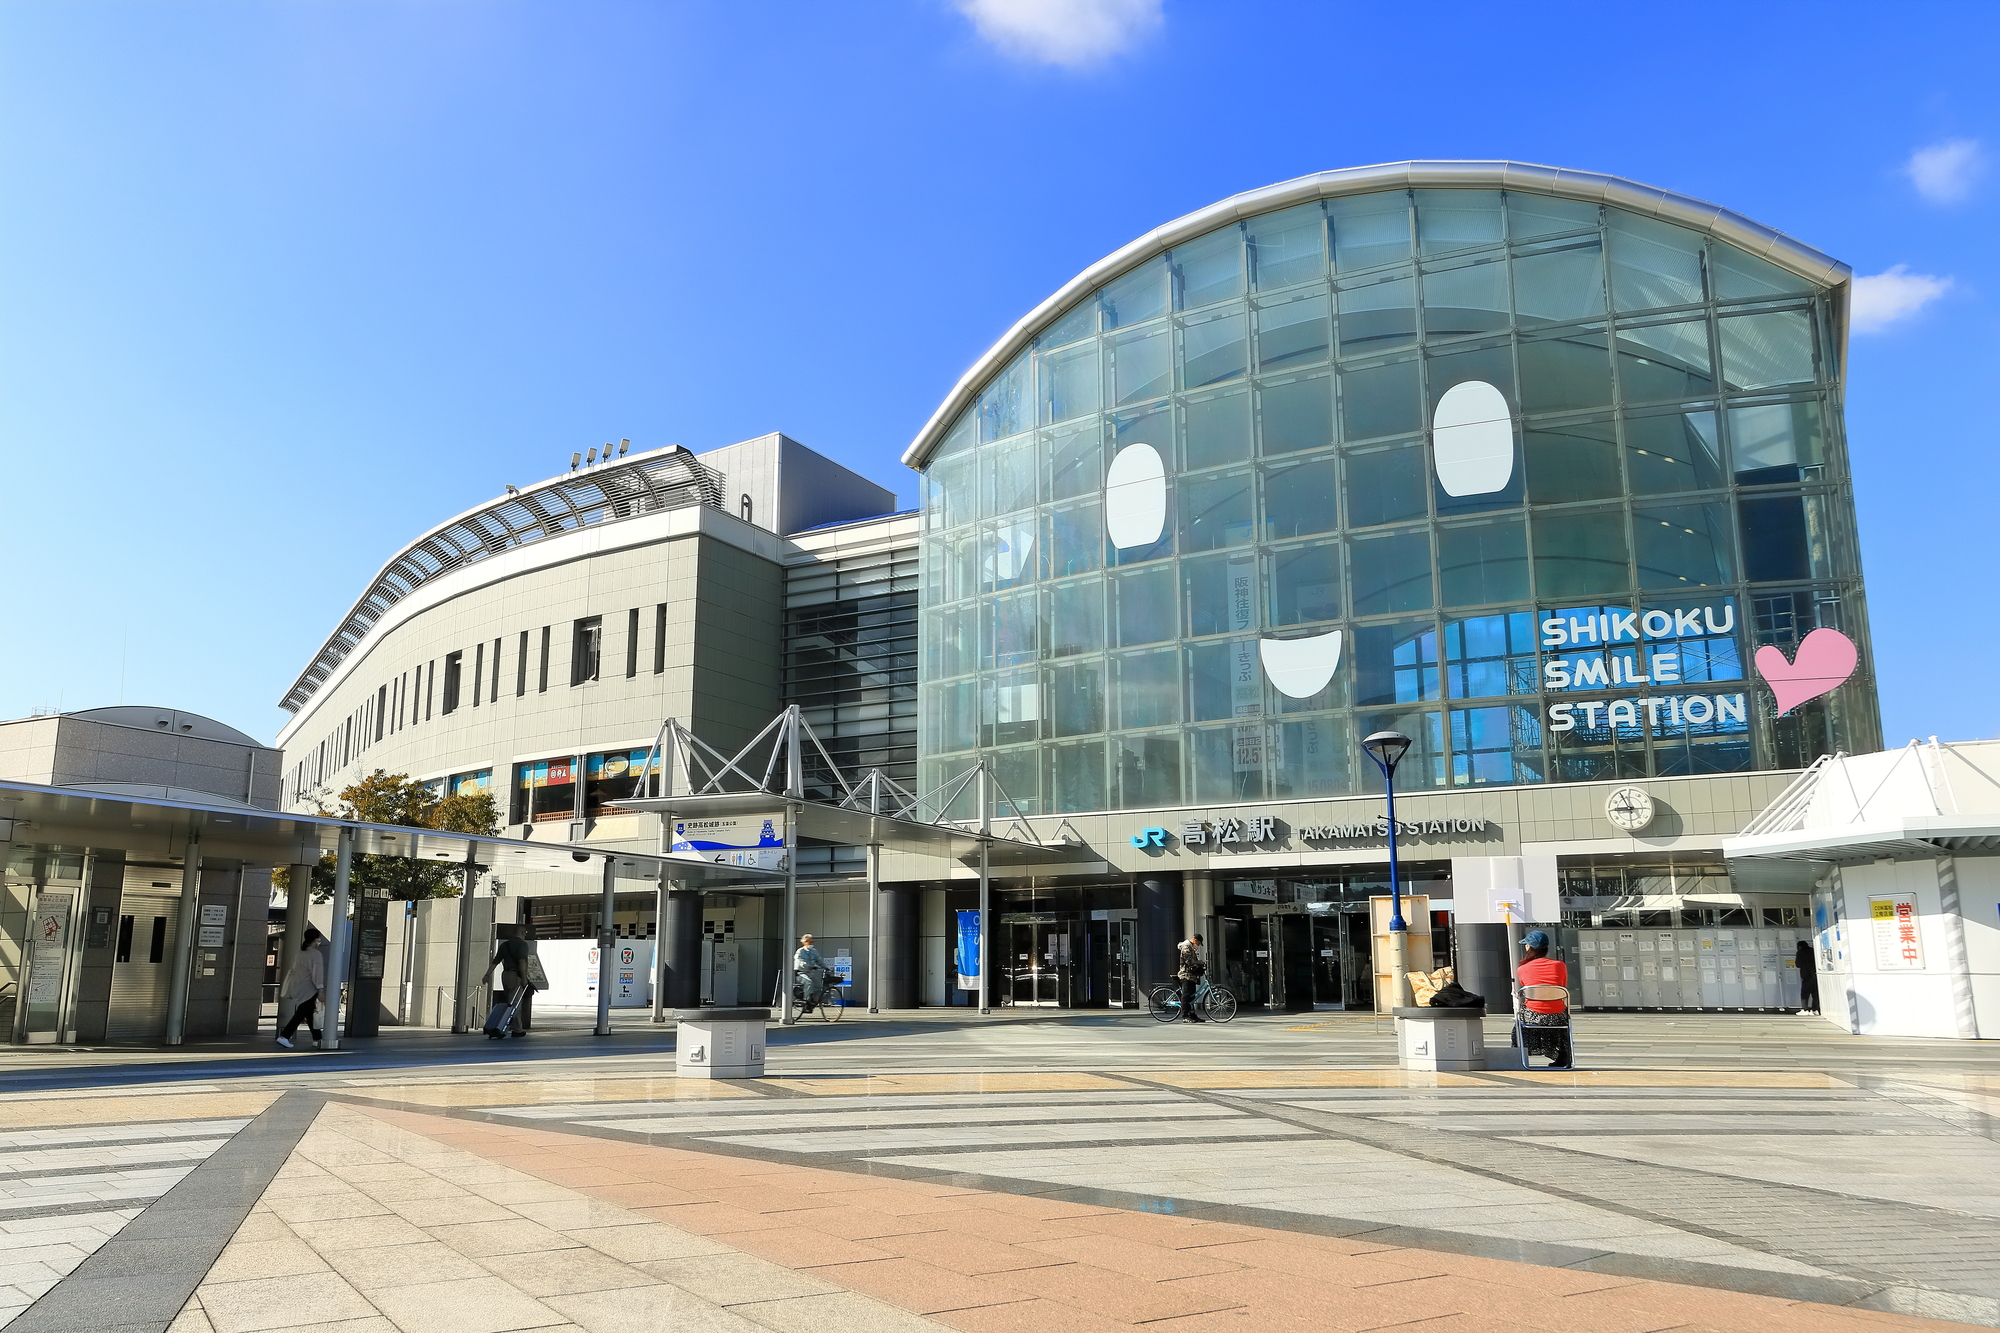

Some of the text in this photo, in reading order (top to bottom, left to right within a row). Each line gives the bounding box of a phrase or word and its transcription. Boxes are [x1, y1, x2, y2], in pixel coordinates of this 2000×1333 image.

[1234, 576, 1252, 681] 阪神往復フーきっぷ
[1542, 605, 1734, 645] SHIKOKU
[1544, 652, 1680, 689] SMILE
[1549, 693, 1745, 732] STATION
[1129, 826, 1166, 848] JR
[1180, 815, 1276, 846] 高松駅
[1406, 817, 1485, 836] STATION
[1896, 903, 1917, 965] 営業中
